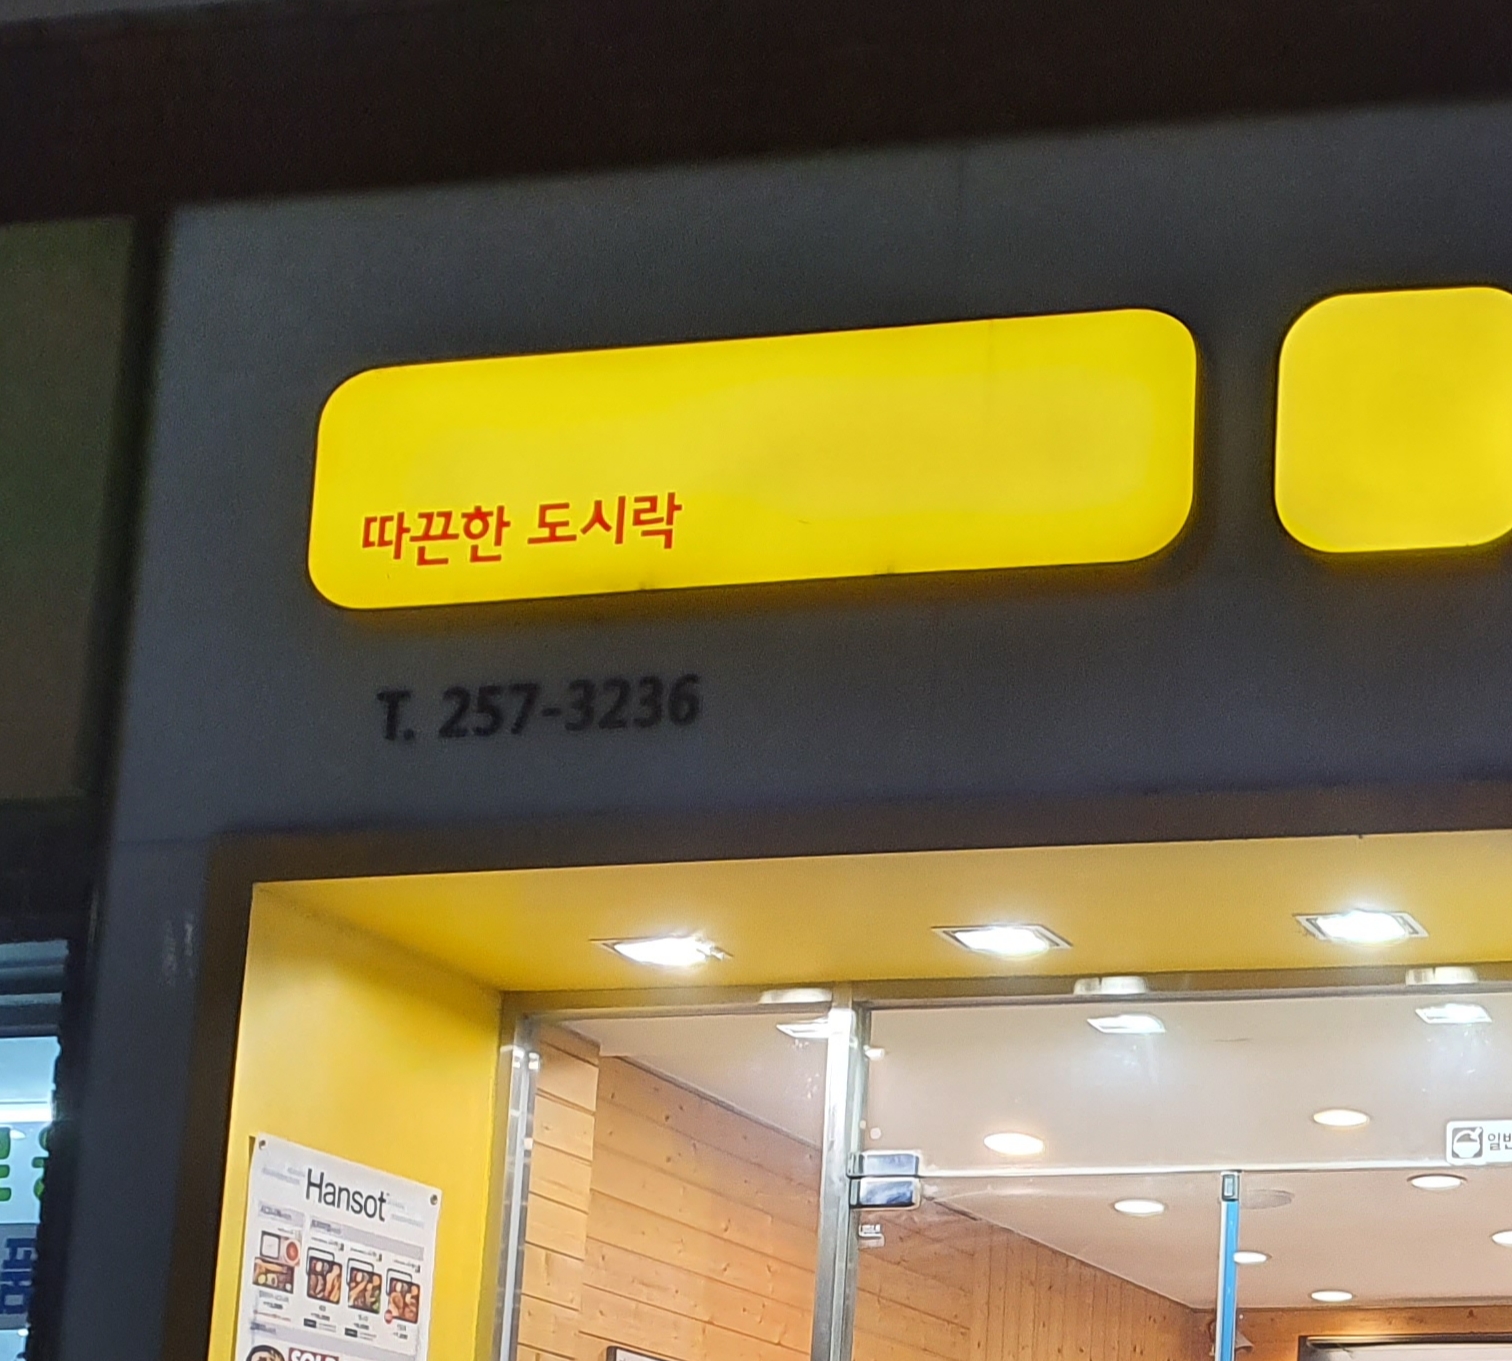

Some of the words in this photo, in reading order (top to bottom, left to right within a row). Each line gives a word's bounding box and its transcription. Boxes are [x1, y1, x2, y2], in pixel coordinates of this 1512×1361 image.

[361, 503, 511, 566] 따끈한
[527, 492, 683, 549] 도시락
[377, 690, 416, 741] T.
[438, 674, 702, 740] 257-3236
[305, 1168, 387, 1222] Hansot
